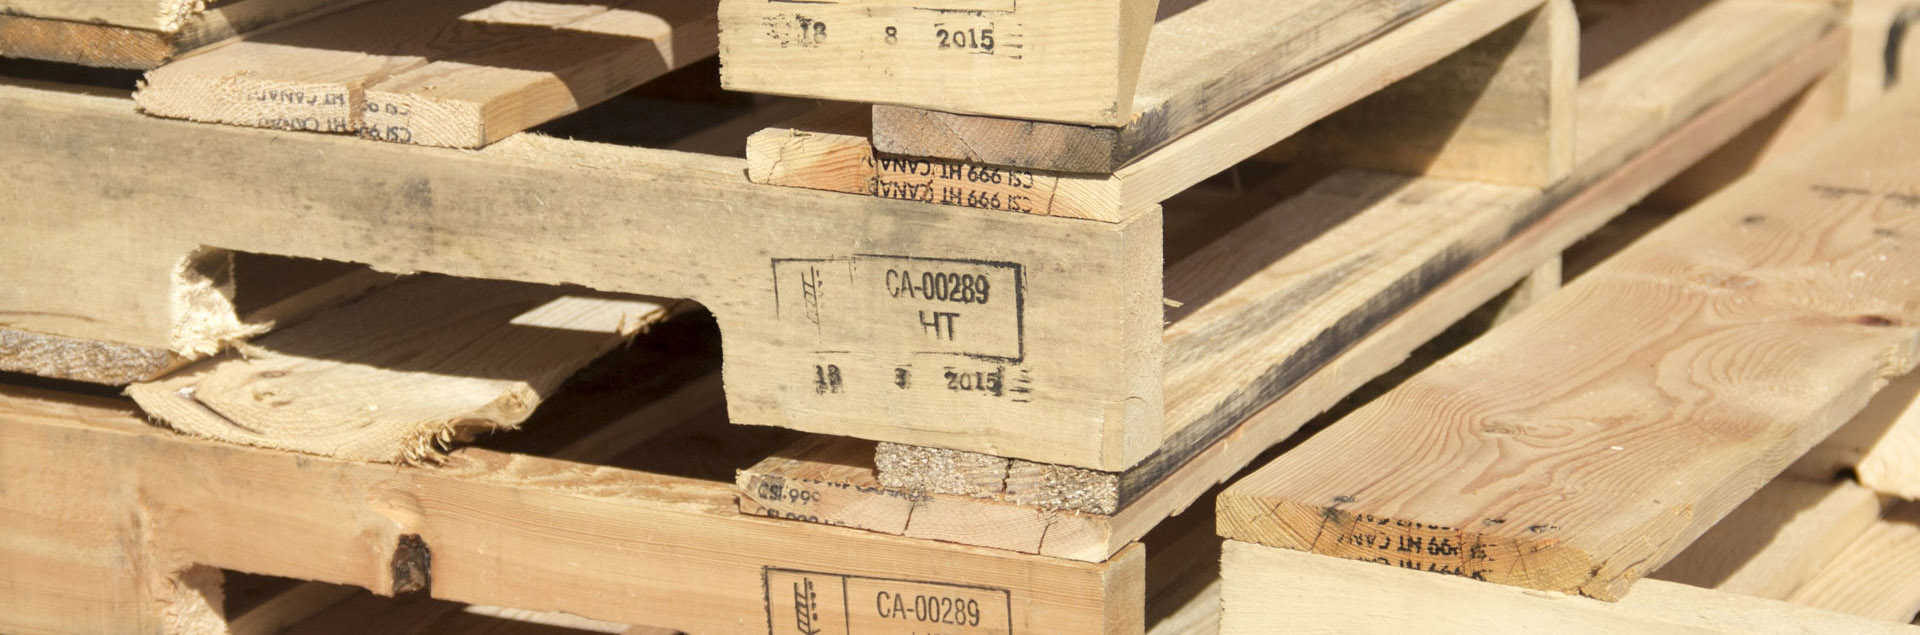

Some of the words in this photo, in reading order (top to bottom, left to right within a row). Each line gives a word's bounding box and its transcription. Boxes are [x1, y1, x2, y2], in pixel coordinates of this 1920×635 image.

[884, 25, 898, 46] 8
[935, 27, 995, 51] 2015
[386, 125, 412, 144] CSI
[940, 164, 962, 181] HT
[967, 166, 1002, 185] 999
[1008, 170, 1034, 190] CSI
[940, 187, 962, 205] HT
[967, 190, 1001, 209] 999
[886, 268, 991, 305] CA-00289
[919, 309, 961, 342] HT
[944, 368, 1001, 395] 2015
[876, 590, 981, 627] CA-00289
